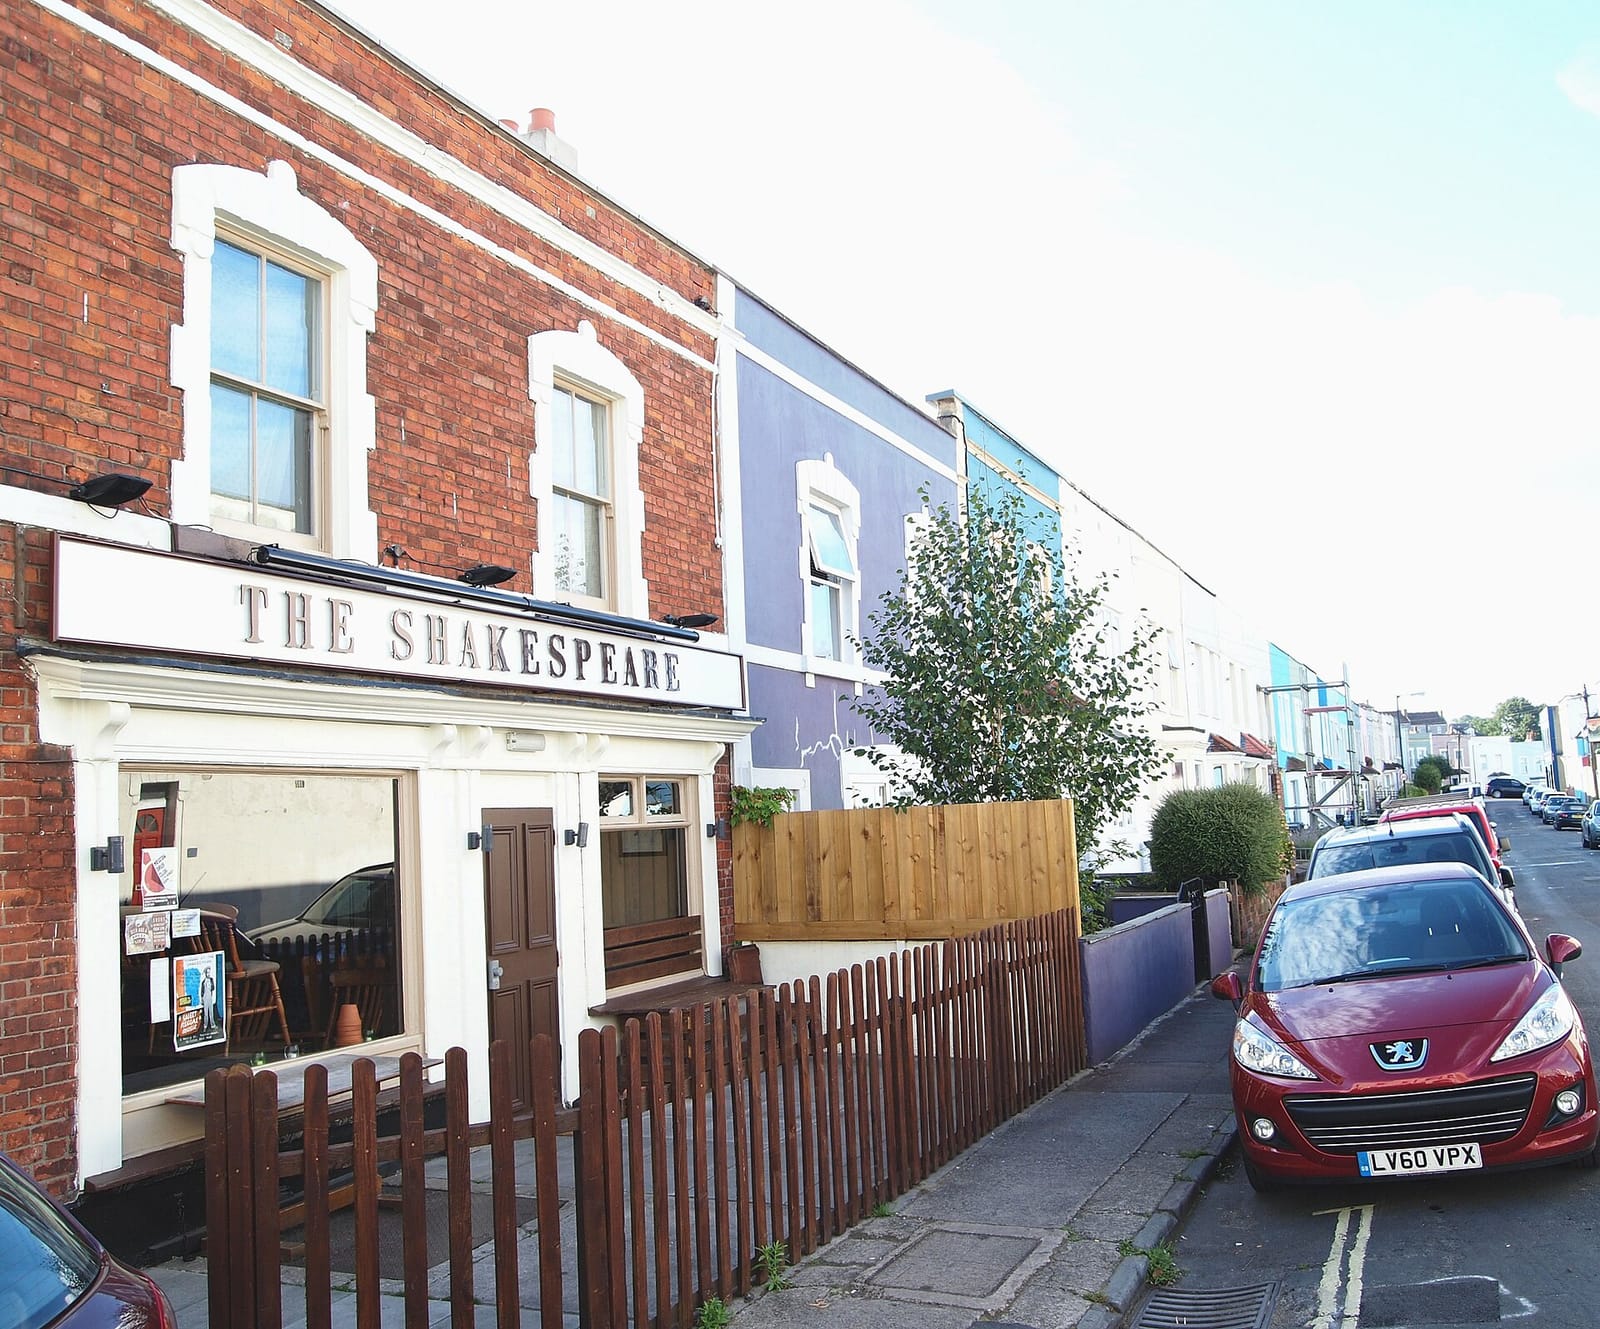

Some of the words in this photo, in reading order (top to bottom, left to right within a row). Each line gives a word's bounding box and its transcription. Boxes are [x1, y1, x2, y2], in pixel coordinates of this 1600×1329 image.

[240, 584, 355, 654] THE
[391, 608, 681, 692] SHAKESPEARE
[1371, 1150, 1427, 1171] LV60
[1433, 1146, 1476, 1166] VPX
